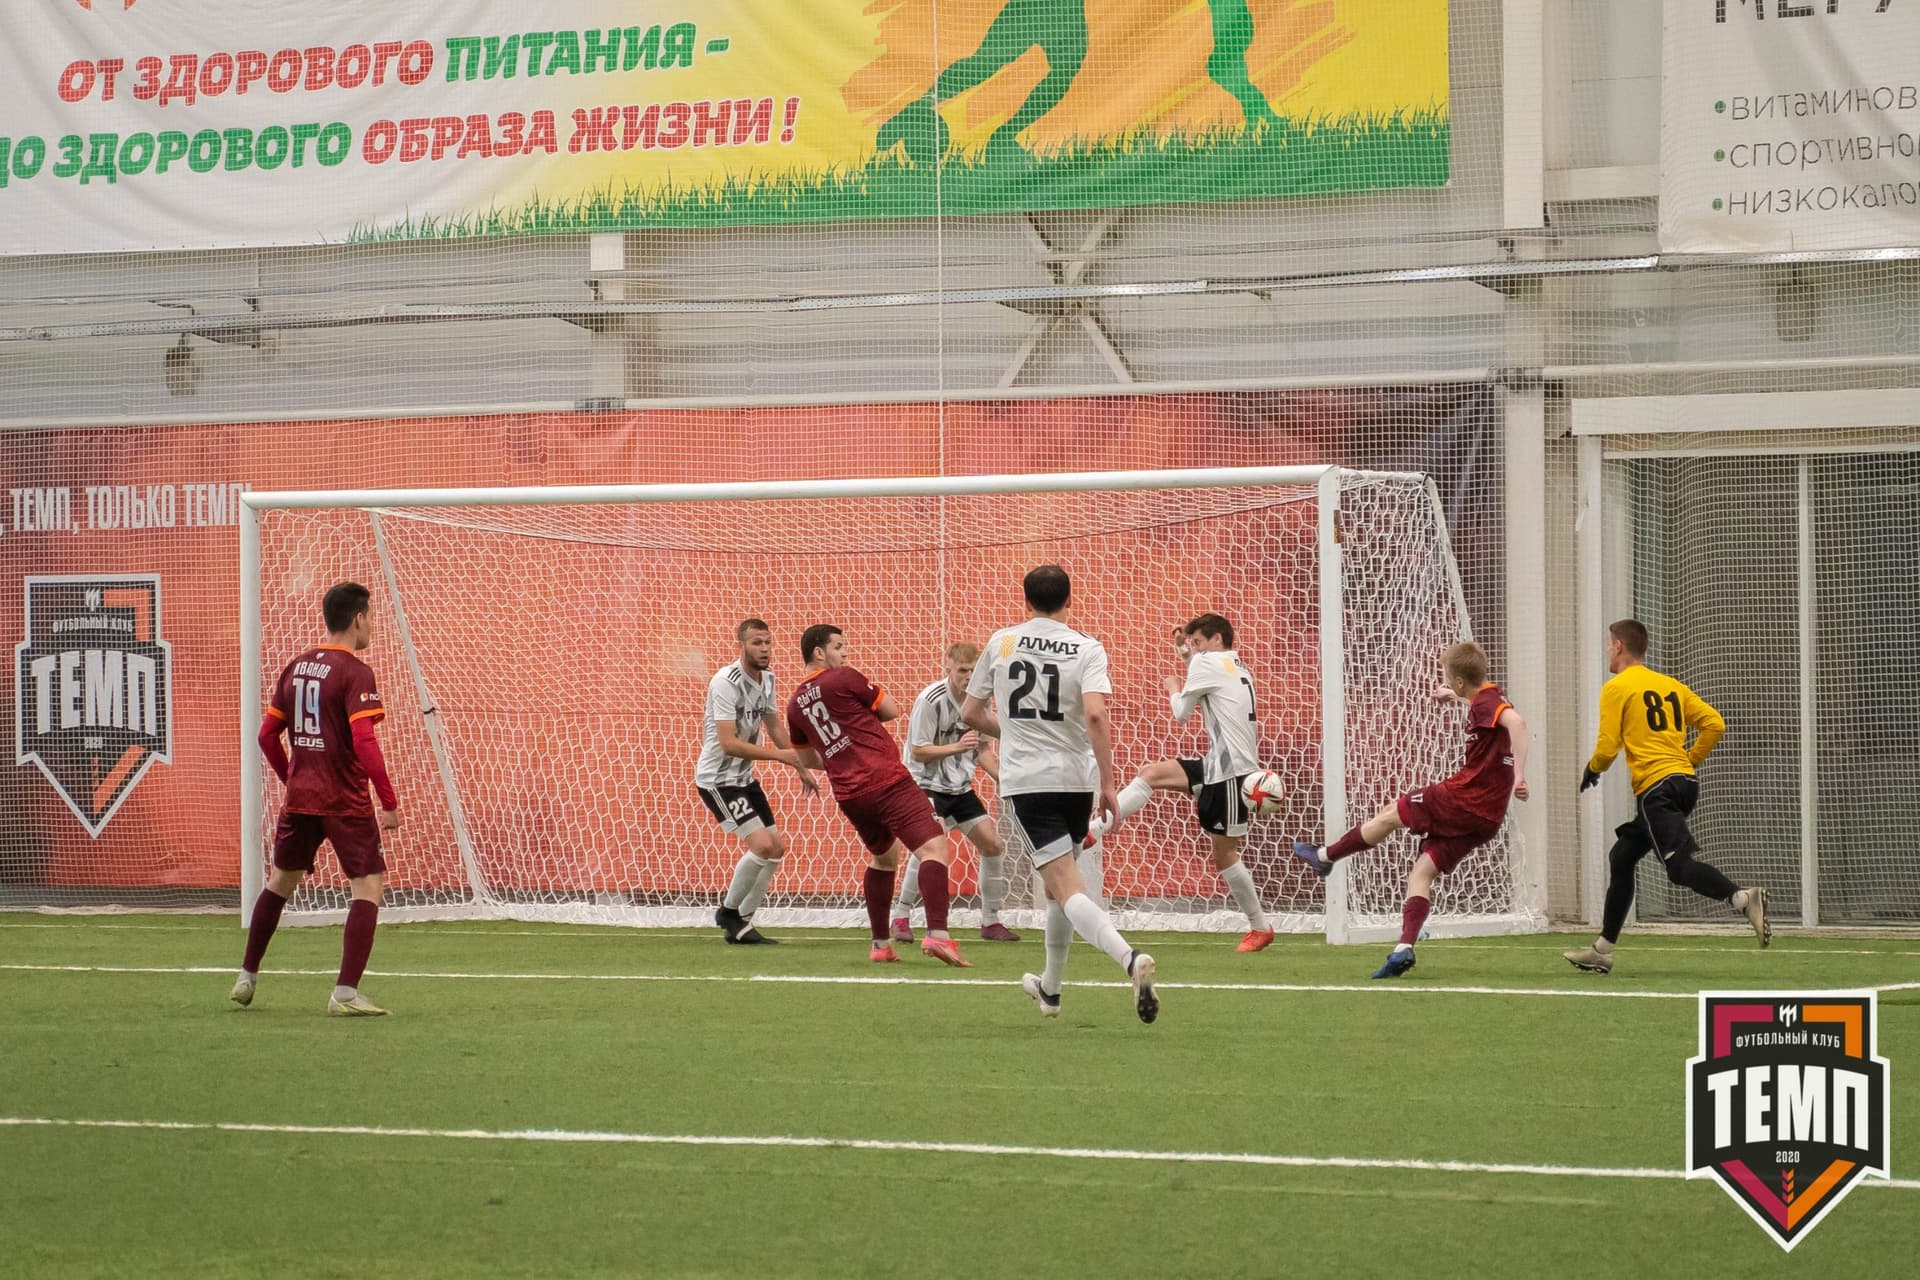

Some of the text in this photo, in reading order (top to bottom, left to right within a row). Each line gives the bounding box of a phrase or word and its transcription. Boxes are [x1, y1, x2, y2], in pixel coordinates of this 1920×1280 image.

[57, 57, 124, 103] ОТ
[132, 39, 434, 108] ЗДОРОВОГО
[446, 22, 697, 83] ПИТАНИЯ
[1731, 86, 1918, 121] витаминов
[52, 121, 352, 186] ЗДОРОВОГО
[361, 109, 559, 165] ОБРАЗА
[1729, 132, 1920, 171] спортивно
[1727, 181, 1920, 216] низкокало
[9, 482, 252, 536] ТЕМП, ТОЛЬКО ТЕМП
[1017, 635, 1081, 656] АЛМАЗ
[31, 649, 156, 738] ТЕМП
[292, 677, 321, 735] 19
[1008, 659, 1065, 722] 21
[1643, 690, 1683, 732] 81
[802, 700, 842, 747] 13
[728, 796, 754, 821] 22
